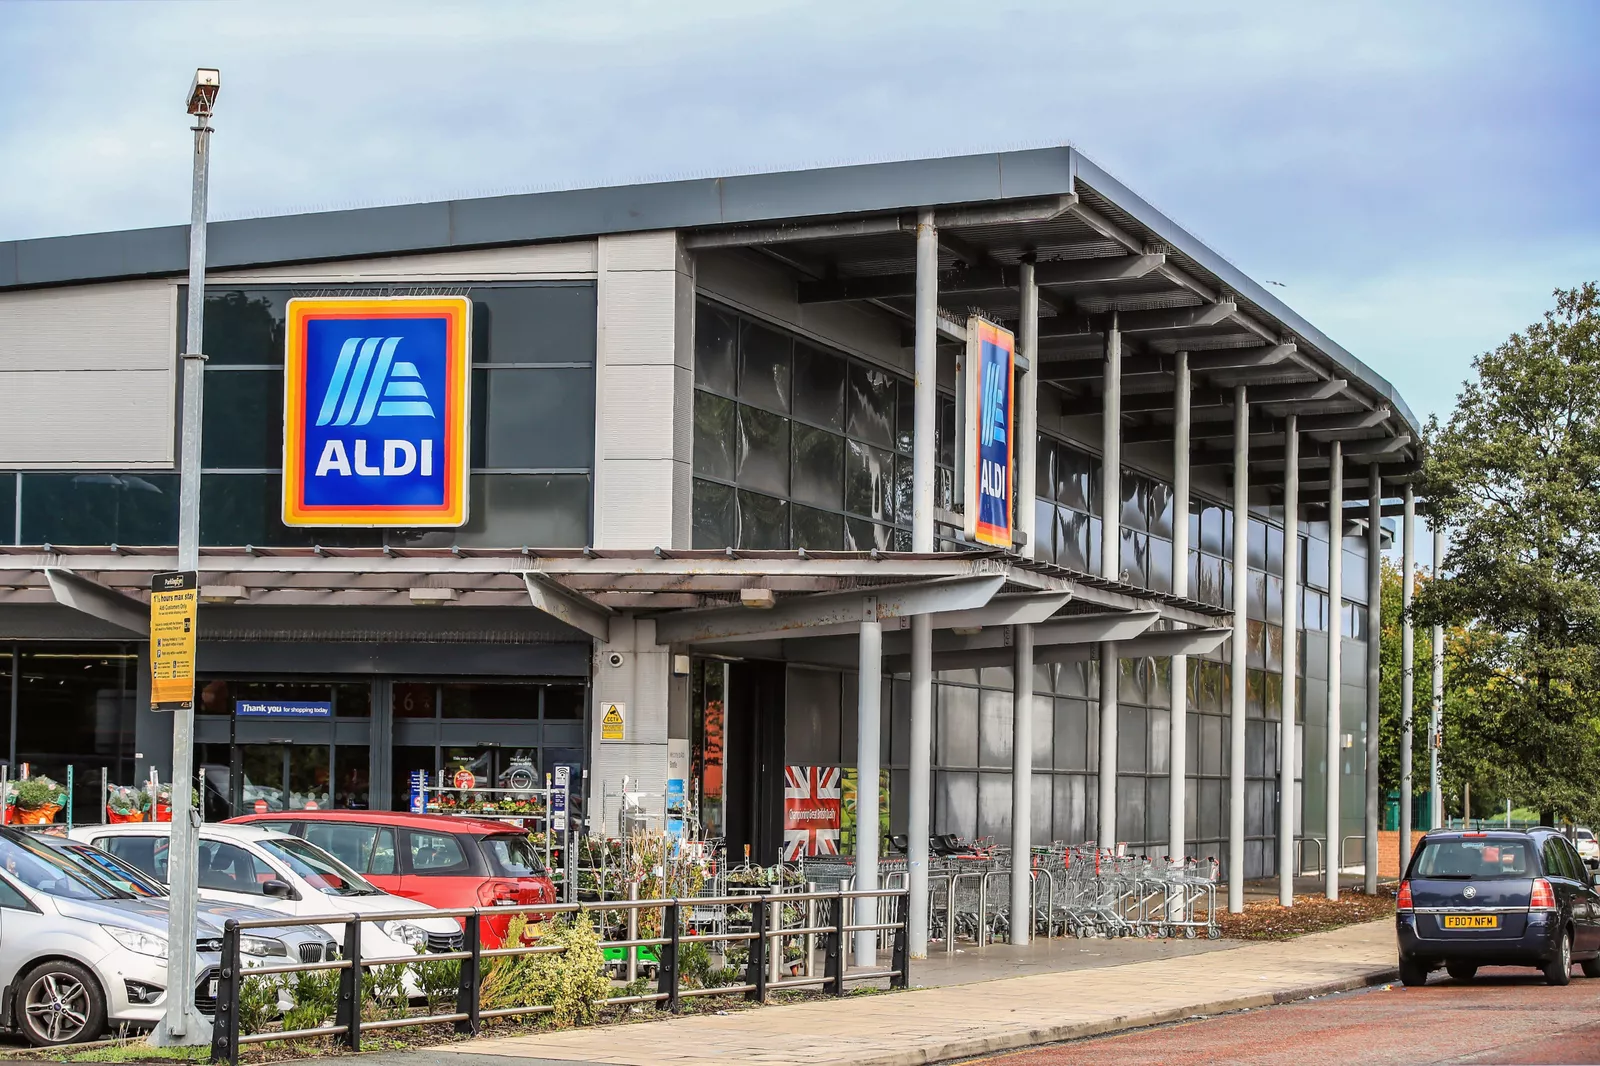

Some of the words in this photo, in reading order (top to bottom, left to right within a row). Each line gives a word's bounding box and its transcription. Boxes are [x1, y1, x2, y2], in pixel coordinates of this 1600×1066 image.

[314, 439, 433, 476] ALDI
[981, 458, 1006, 500] ALDI
[161, 594, 174, 602] hours
[184, 592, 195, 602] stay
[242, 703, 267, 713] Thank
[267, 705, 282, 714] you
[290, 706, 314, 714] shopping
[313, 707, 329, 715] today
[1448, 916, 1473, 926] FD07
[1474, 916, 1493, 926] NFM
